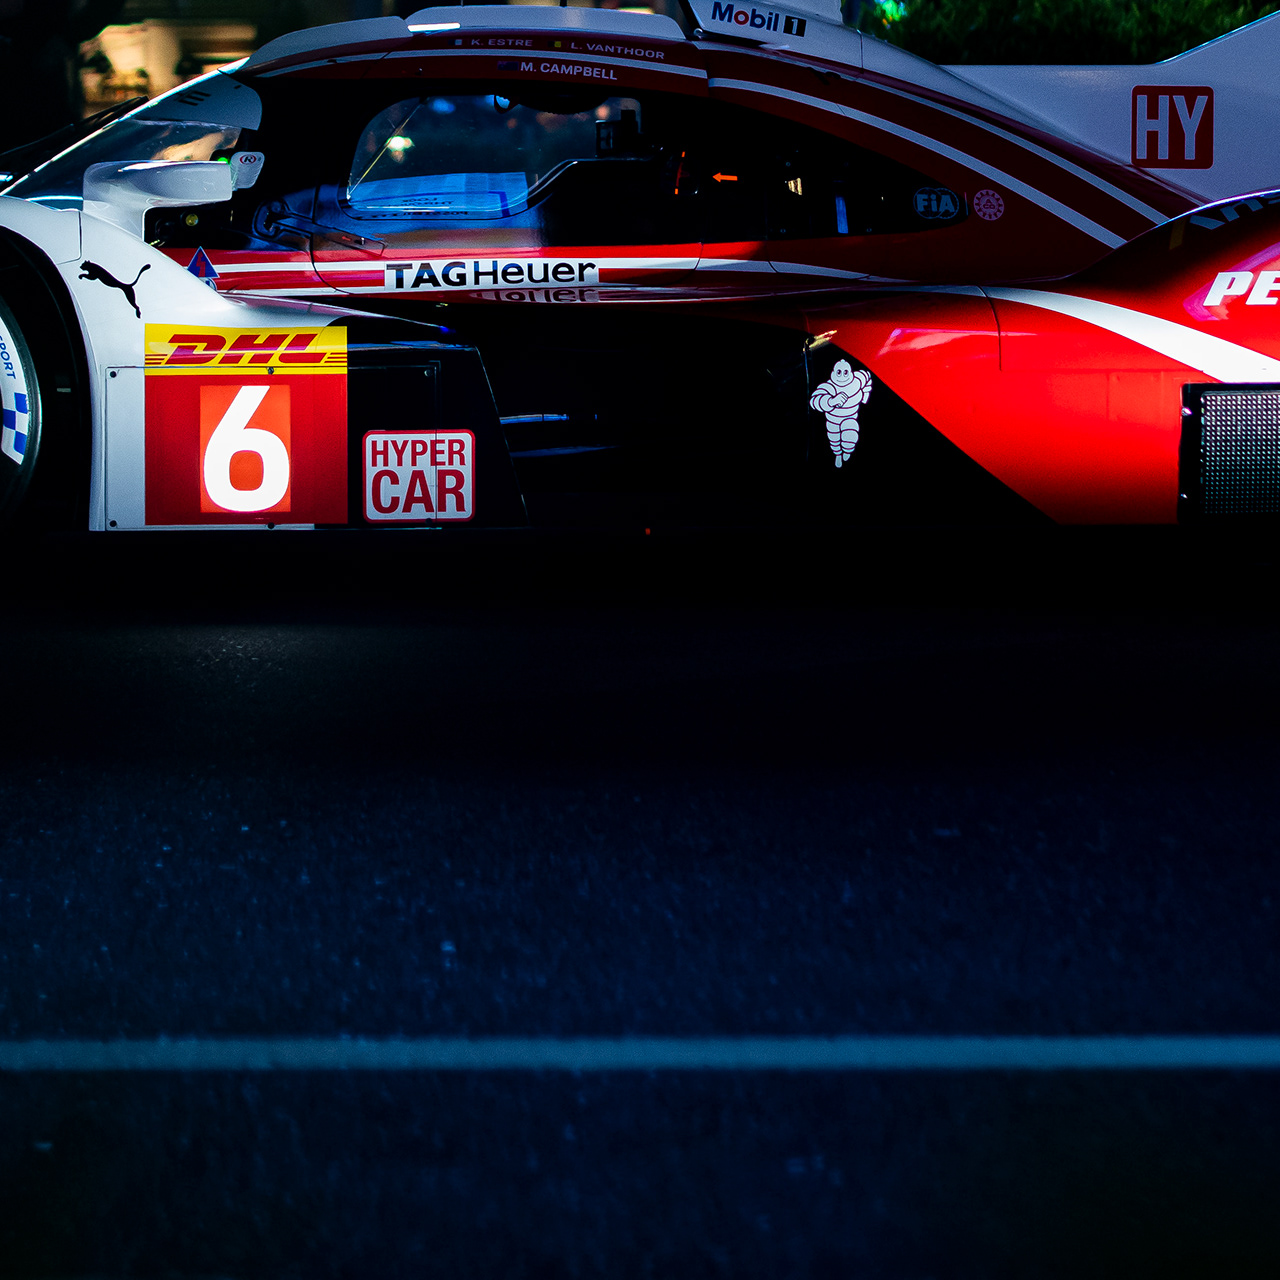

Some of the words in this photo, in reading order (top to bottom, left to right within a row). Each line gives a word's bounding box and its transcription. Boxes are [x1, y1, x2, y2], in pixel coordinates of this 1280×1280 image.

[711, 1, 780, 31] Mobil
[488, 38, 533, 47] ESTRE
[570, 42, 583, 51] L.
[587, 42, 665, 60] VANTHOOR
[520, 61, 537, 73] M.
[540, 62, 618, 81] CAMPBELL
[1136, 94, 1208, 160] HY
[167, 333, 328, 365] DHL
[203, 385, 291, 513] 6
[371, 439, 466, 467] HYPER
[371, 469, 466, 514] CAR
